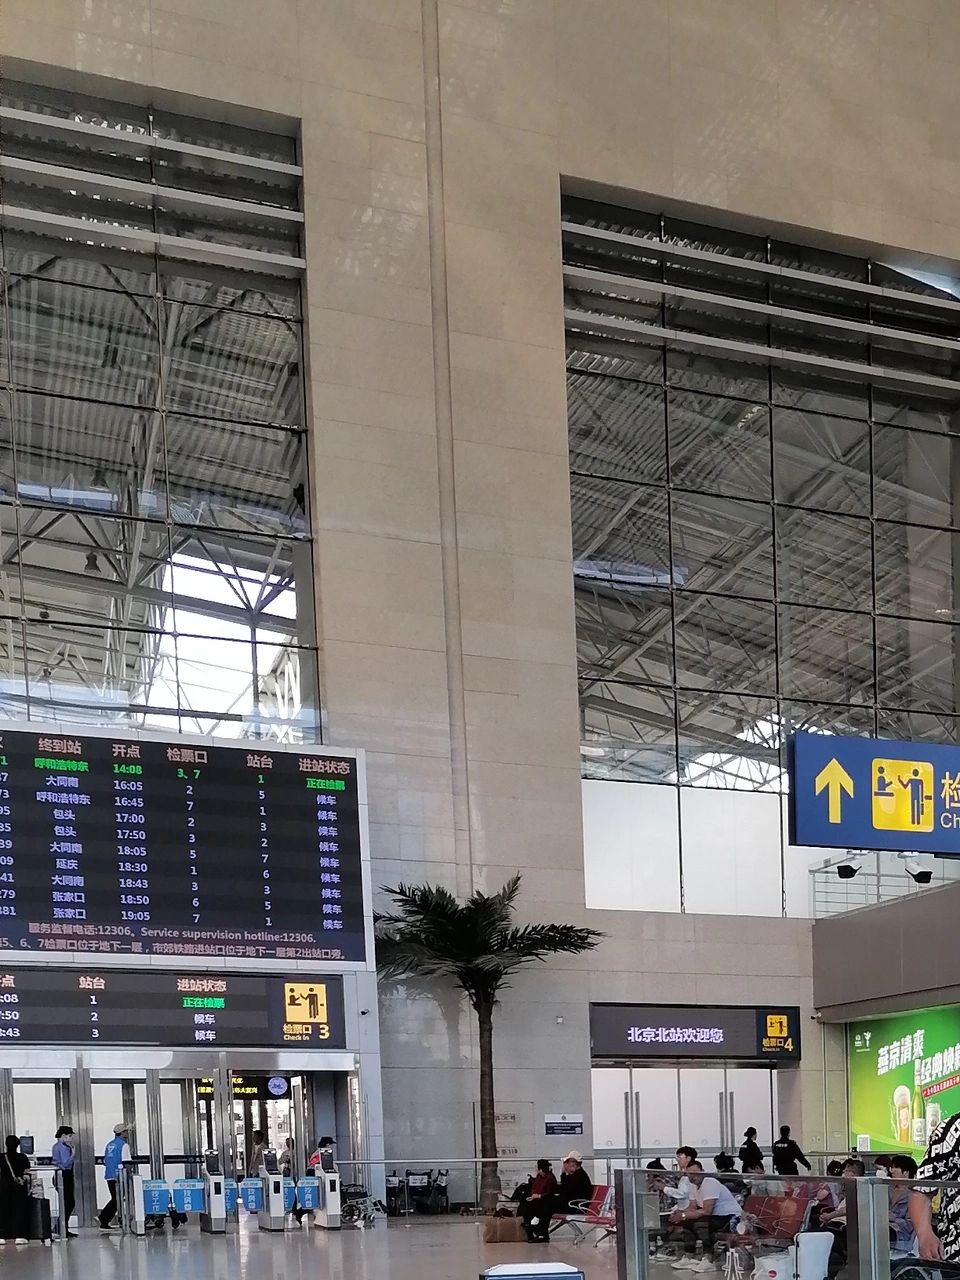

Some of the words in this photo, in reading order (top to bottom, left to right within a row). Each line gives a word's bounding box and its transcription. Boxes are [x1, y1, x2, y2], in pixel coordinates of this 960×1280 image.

[38, 738, 82, 754] 终到站
[112, 744, 140, 758] 开点
[167, 748, 207, 763] 检票口
[246, 754, 273, 768] 站台
[299, 758, 350, 774] 进站状态
[113, 764, 142, 774] 14:08
[258, 775, 264, 783] 1
[46, 775, 78, 788] 大同南
[114, 781, 143, 791] 16:05
[187, 786, 193, 794] 2
[259, 791, 265, 799] 5
[317, 795, 336, 805] 候车
[115, 797, 144, 807] 16:45
[187, 802, 193, 810] 7
[260, 807, 266, 815] 1
[318, 811, 337, 821] 候车
[53, 809, 75, 820] 包头
[116, 814, 145, 823] 17:00
[188, 818, 194, 826] 2
[260, 823, 267, 831] 3
[318, 826, 338, 837] 候车
[54, 826, 76, 837] 包头
[117, 830, 146, 840] 17:50
[189, 834, 195, 842] 3
[261, 839, 268, 847] 2
[319, 842, 339, 852] 候车
[50, 842, 82, 854] 大同南
[118, 846, 146, 856] 18:05
[190, 850, 196, 858] 5
[262, 855, 268, 863] 7
[320, 858, 339, 868] 候车
[56, 859, 78, 870] 延庆
[118, 862, 147, 872] 18:30
[190, 867, 198, 875] 1
[263, 870, 269, 878] 6
[321, 873, 341, 883] 候车
[52, 876, 84, 887] 大同南
[119, 878, 148, 888] 18:43
[192, 882, 198, 890] 3
[264, 886, 270, 894] 3
[322, 889, 341, 899] 候车
[53, 892, 85, 903] 张家口
[120, 895, 149, 904] 18:50
[192, 898, 199, 907] 6
[265, 902, 271, 910] 5
[322, 904, 342, 914] 候车
[53, 908, 86, 920] 张家口
[121, 911, 150, 921] 19:05
[193, 914, 200, 923] 7
[265, 918, 272, 926] 1
[323, 920, 343, 930] 候车
[141, 928, 179, 937] Service
[182, 930, 242, 940] supervision
[245, 932, 316, 943] hotline:12306.
[79, 976, 106, 990] 站台
[176, 978, 226, 992] 进站状态
[90, 996, 97, 1004] 1
[91, 1012, 98, 1021] 2
[194, 1014, 216, 1024] 候车
[92, 1029, 99, 1038] 3
[194, 1030, 216, 1041] 候车
[318, 1026, 330, 1039] 3
[627, 1026, 724, 1044] 北京北站欢迎您
[784, 1038, 793, 1051] 4
[878, 1030, 924, 1076] 燕京清爽
